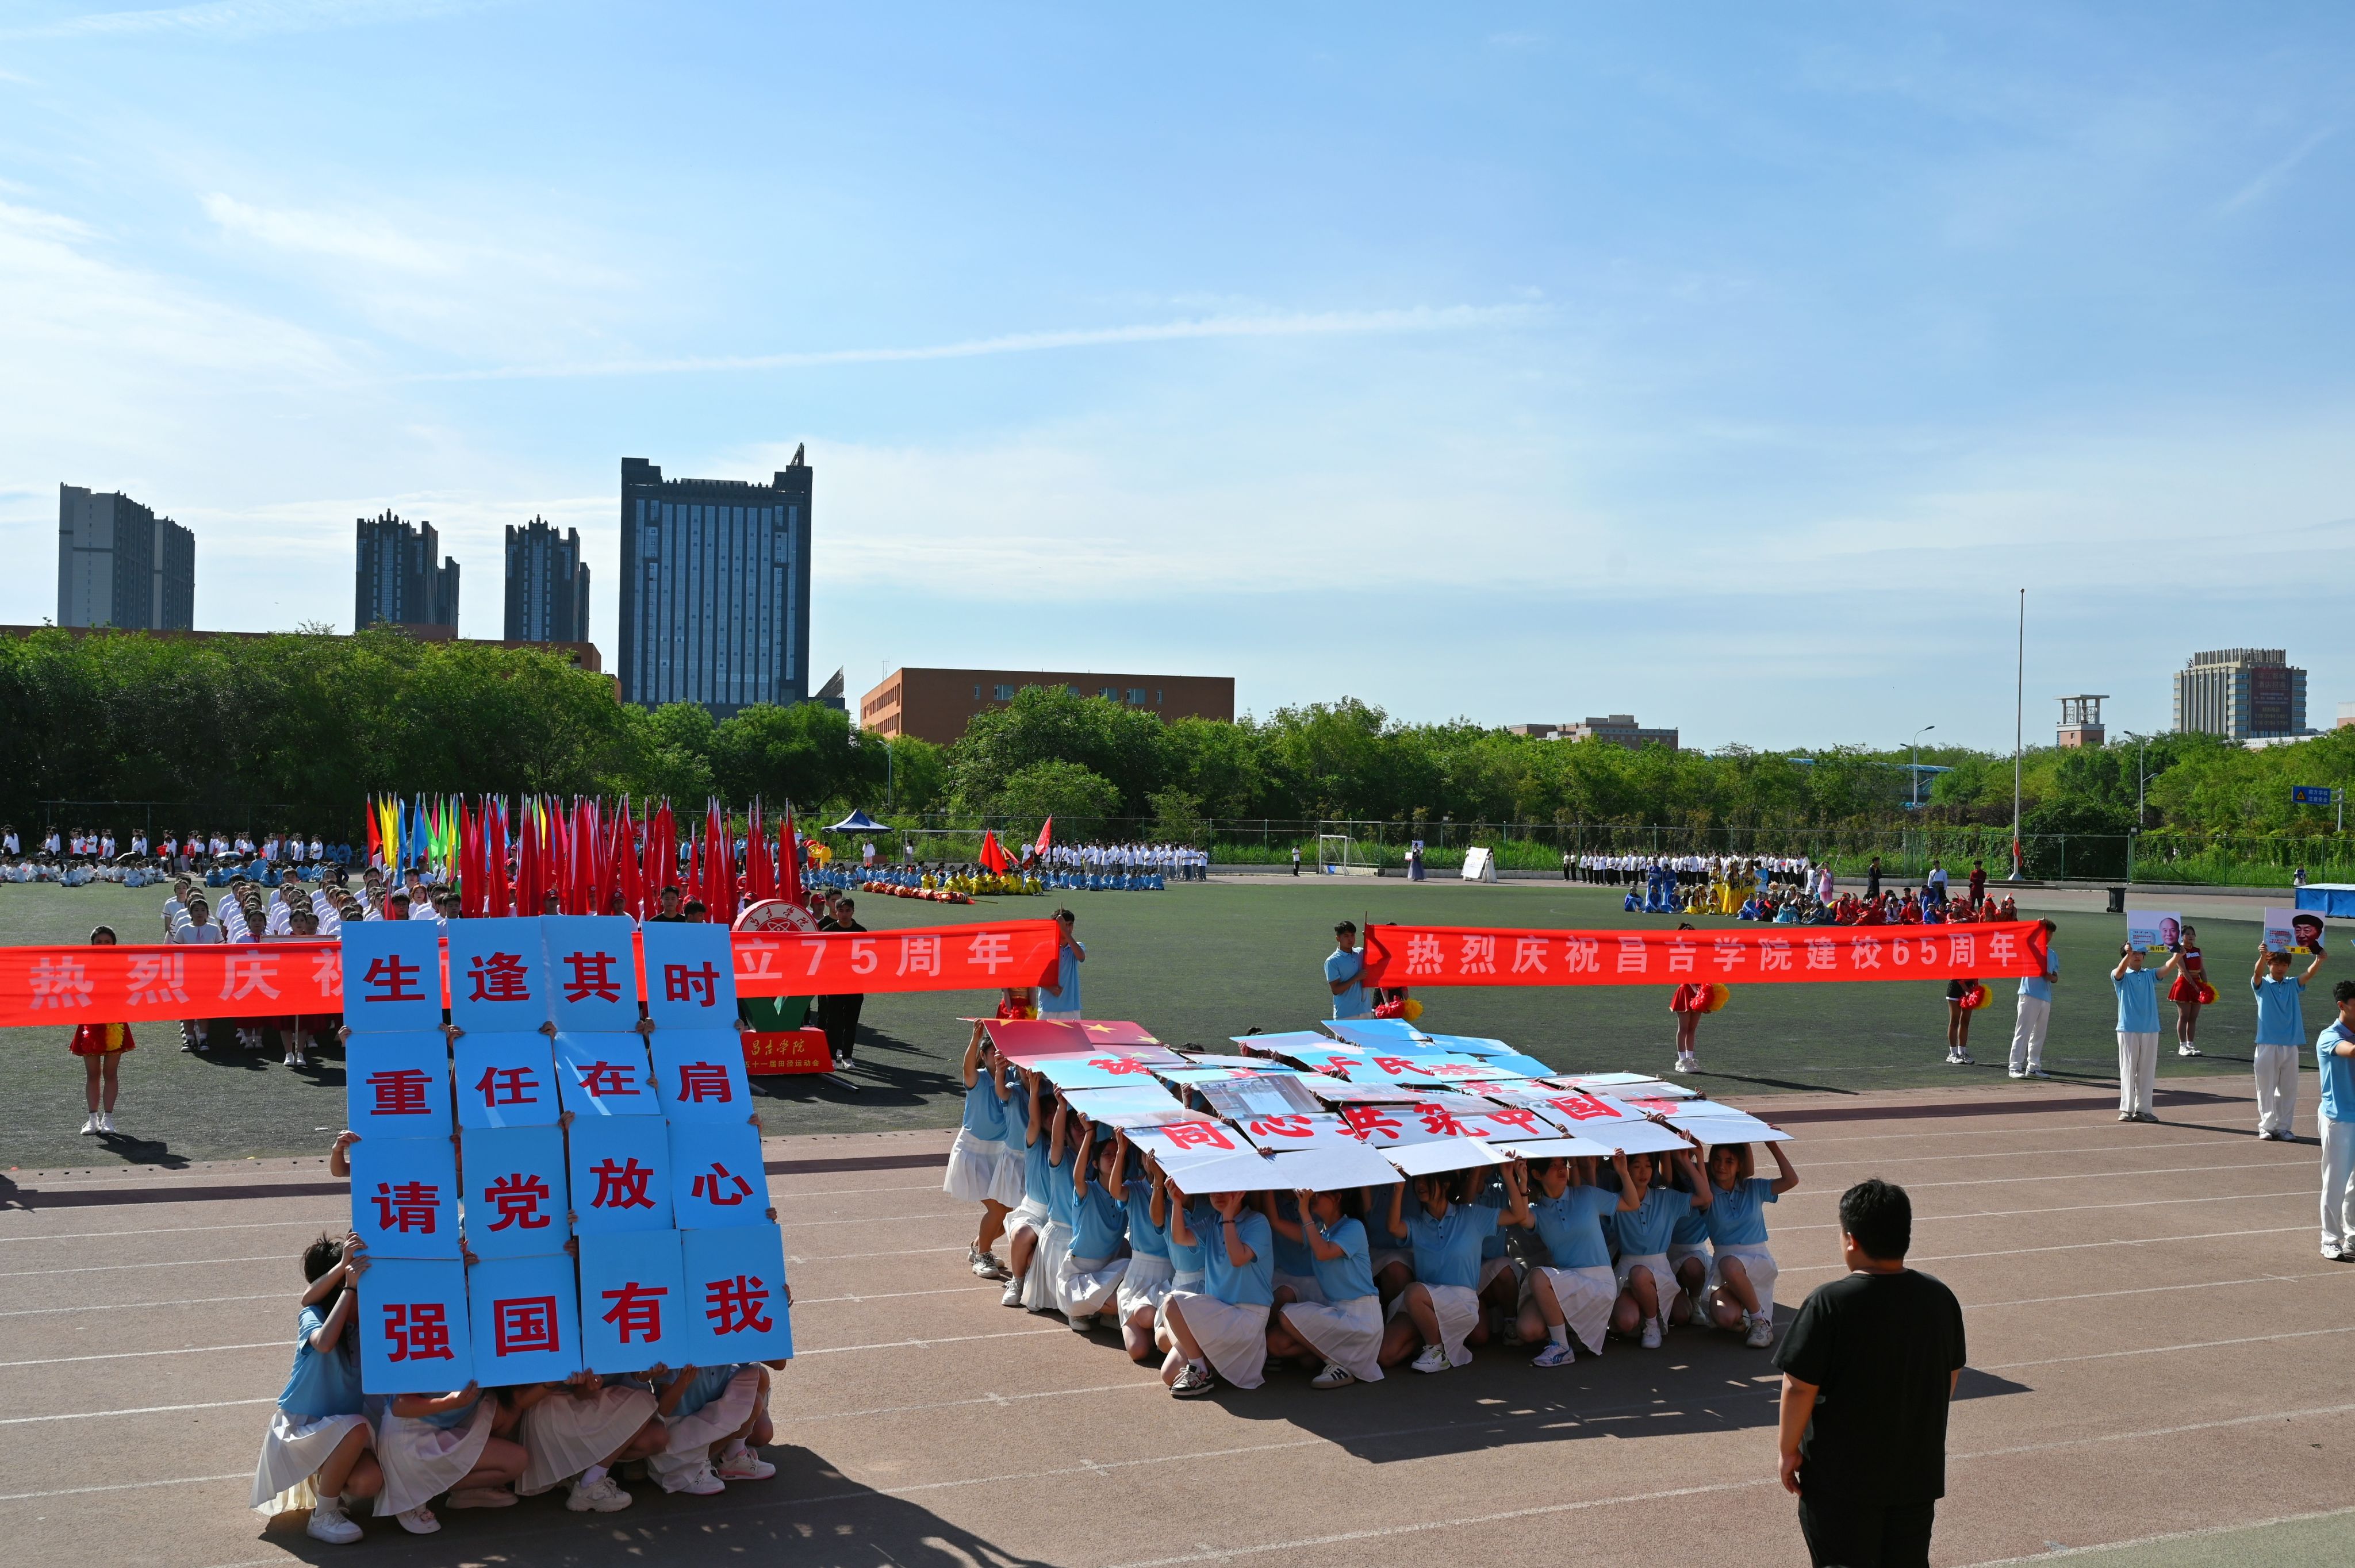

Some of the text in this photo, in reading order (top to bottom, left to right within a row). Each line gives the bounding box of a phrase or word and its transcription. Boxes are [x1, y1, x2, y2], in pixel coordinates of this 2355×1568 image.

[364, 951, 720, 1008] 生逢其时
[734, 931, 1013, 979] 立75周年
[1405, 931, 2017, 975] 热烈庆祝昌吉学院建校65周年
[366, 1060, 732, 1115] 重任在肩
[371, 1158, 754, 1234] 请党放心
[382, 1275, 773, 1362] 强国有我
